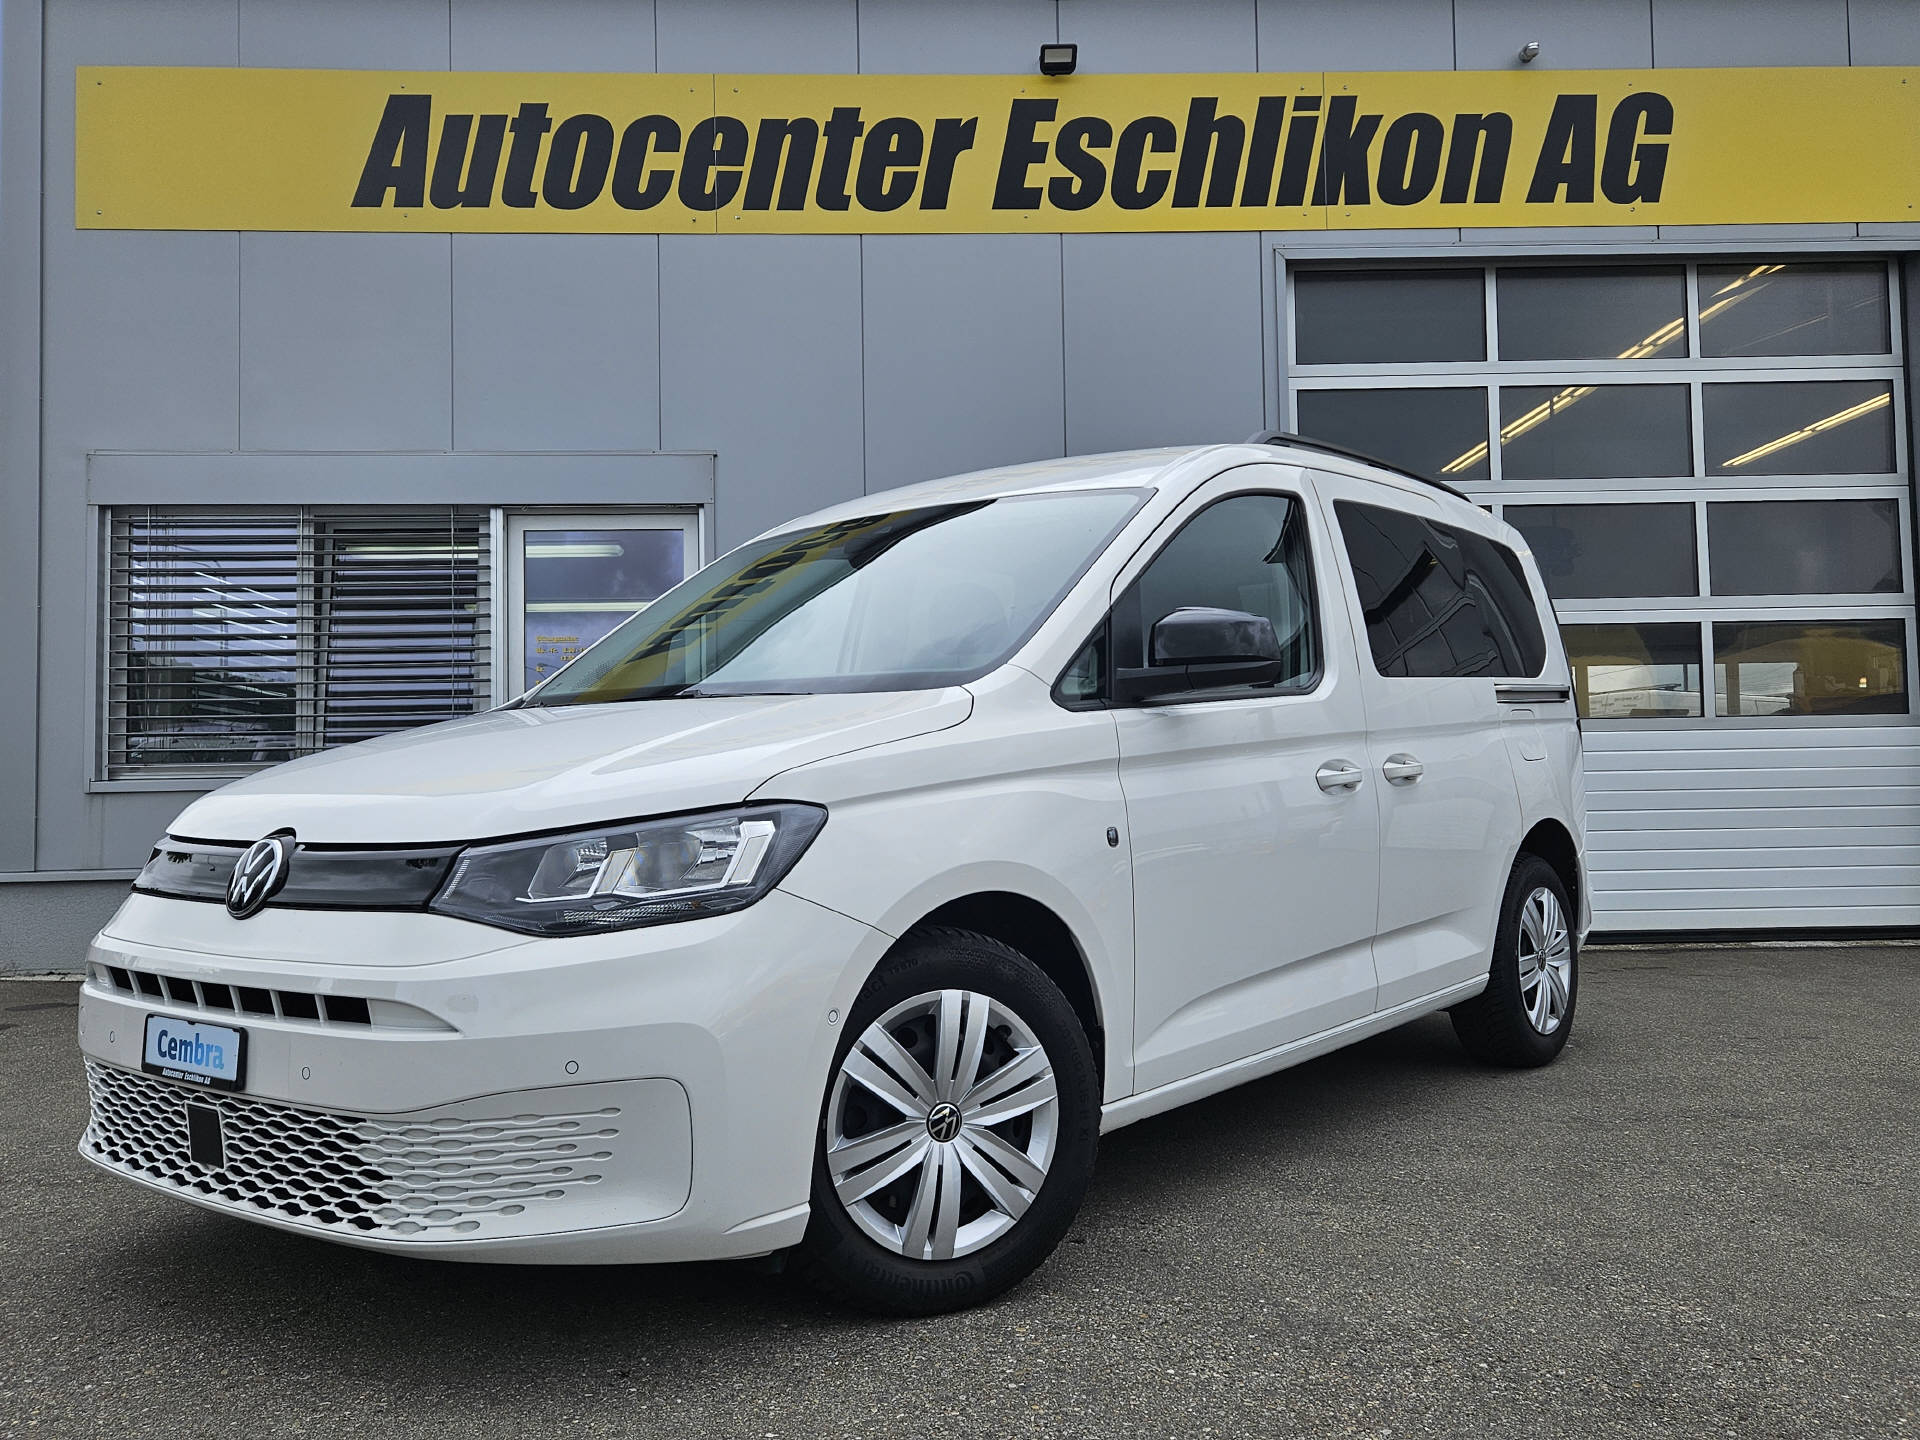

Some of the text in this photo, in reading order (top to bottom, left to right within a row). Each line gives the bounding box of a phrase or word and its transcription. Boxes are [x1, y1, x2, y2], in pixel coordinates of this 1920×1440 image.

[351, 92, 1674, 212] Autocenter Eschlikon AG
[157, 1029, 225, 1070] Cembra
[161, 1067, 184, 1080] Autocenter
[184, 1071, 204, 1083] Eschlikon
